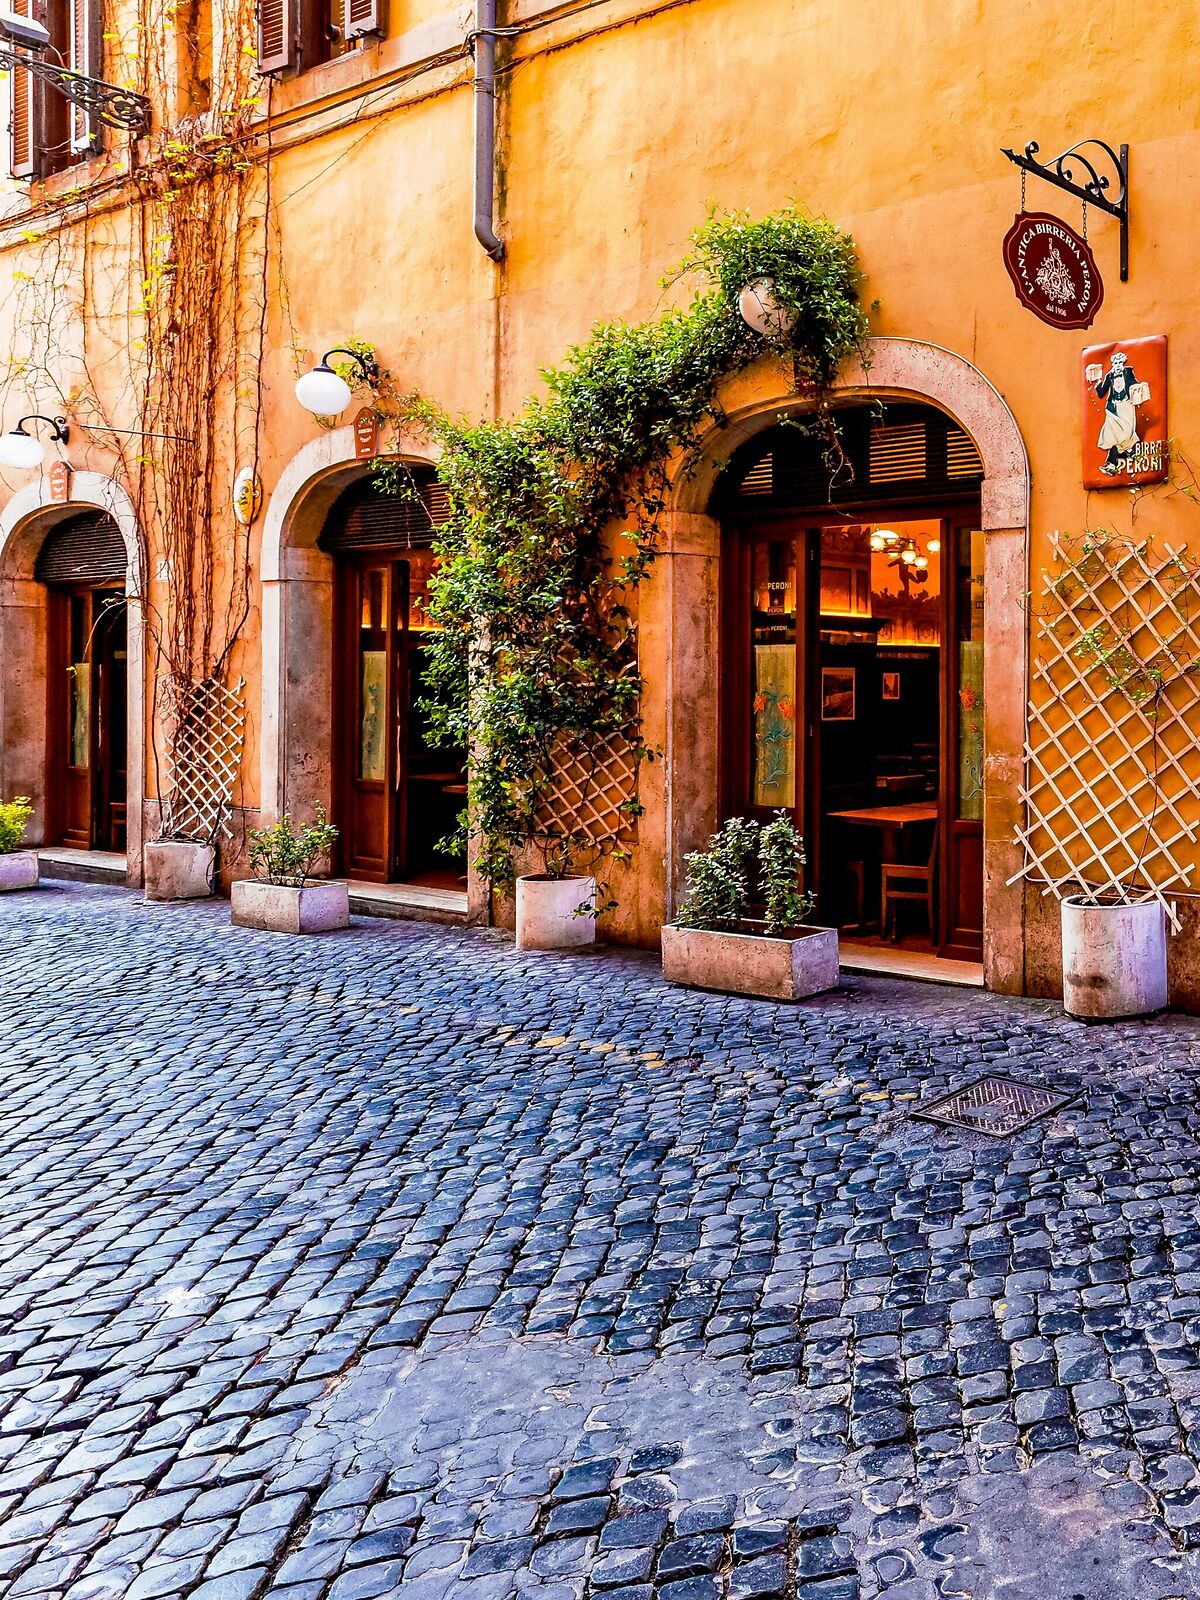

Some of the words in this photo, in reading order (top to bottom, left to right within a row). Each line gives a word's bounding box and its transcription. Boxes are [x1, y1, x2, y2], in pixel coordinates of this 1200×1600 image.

[1018, 228, 1036, 295] L'ANTICA
[1035, 223, 1081, 259] BIRRERIA
[1077, 260, 1091, 313] PERONI
[1046, 303, 1055, 313] dal
[1055, 306, 1067, 316] 1906
[1135, 440, 1162, 456] BIRRA
[1117, 456, 1162, 474] PERONI
[767, 582, 792, 590] PERONI
